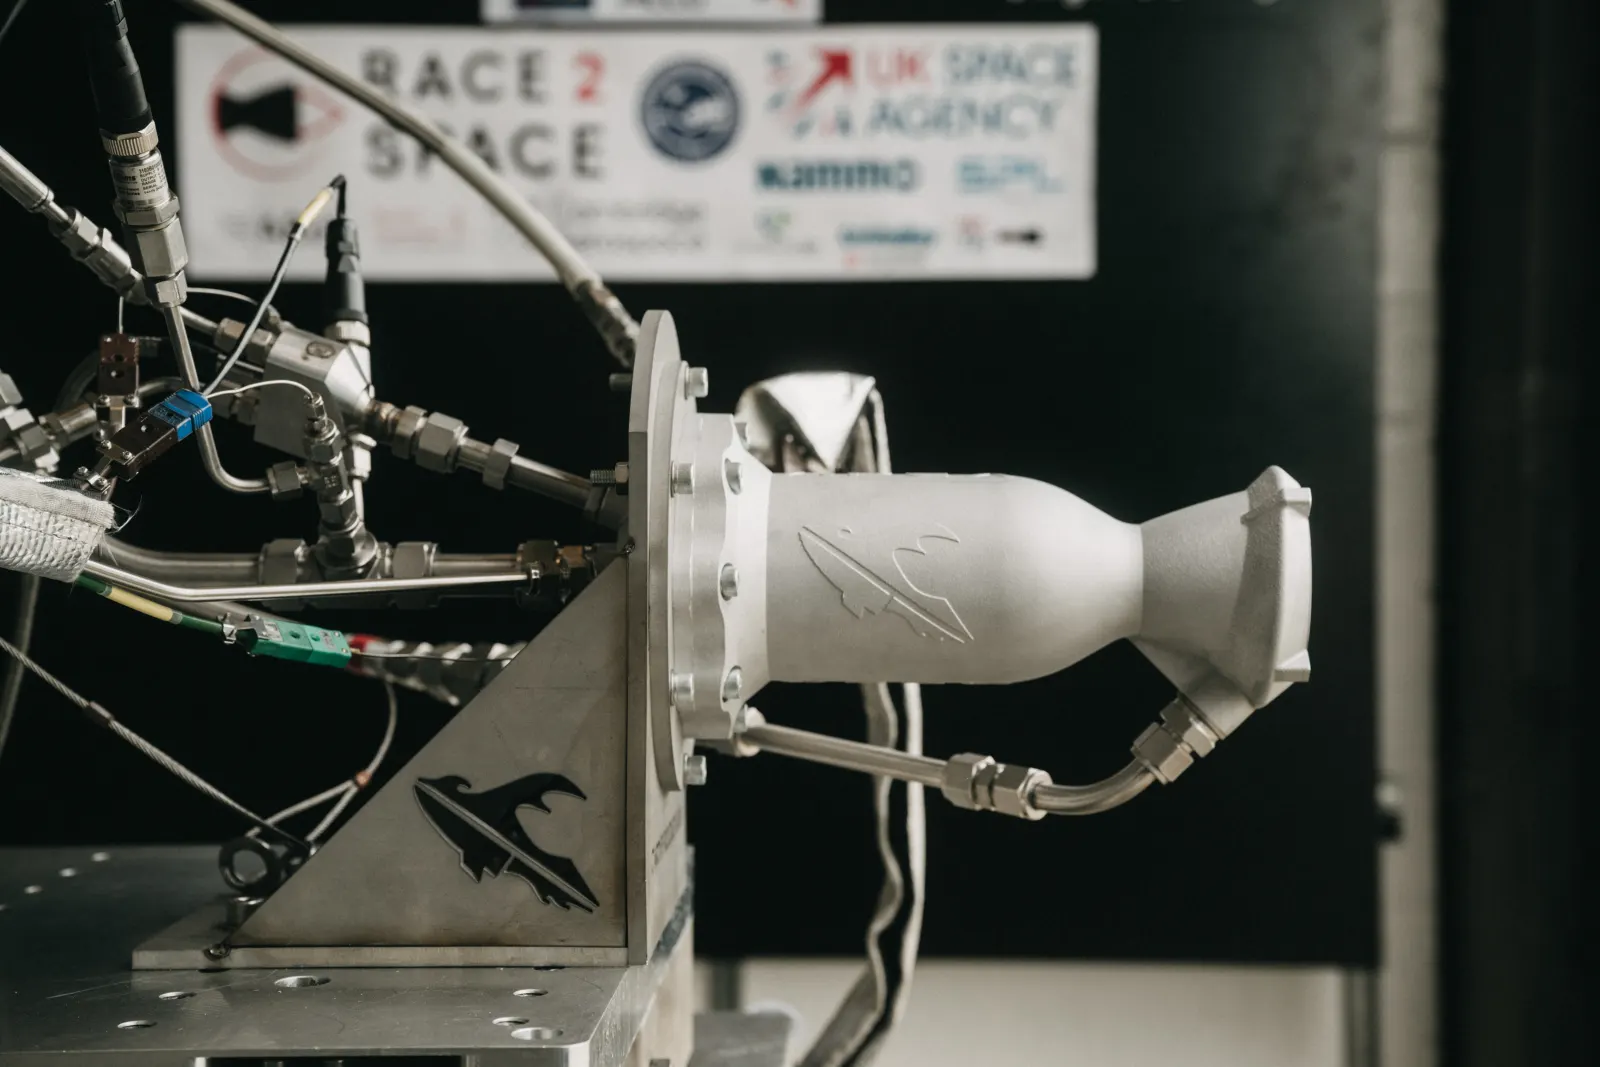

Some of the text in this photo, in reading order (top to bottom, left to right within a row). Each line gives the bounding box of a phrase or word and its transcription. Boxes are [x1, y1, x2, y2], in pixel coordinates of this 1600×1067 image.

[361, 49, 605, 104] RACE 2
[866, 44, 1078, 89] UK SPACE
[864, 95, 1065, 141] AGENCY
